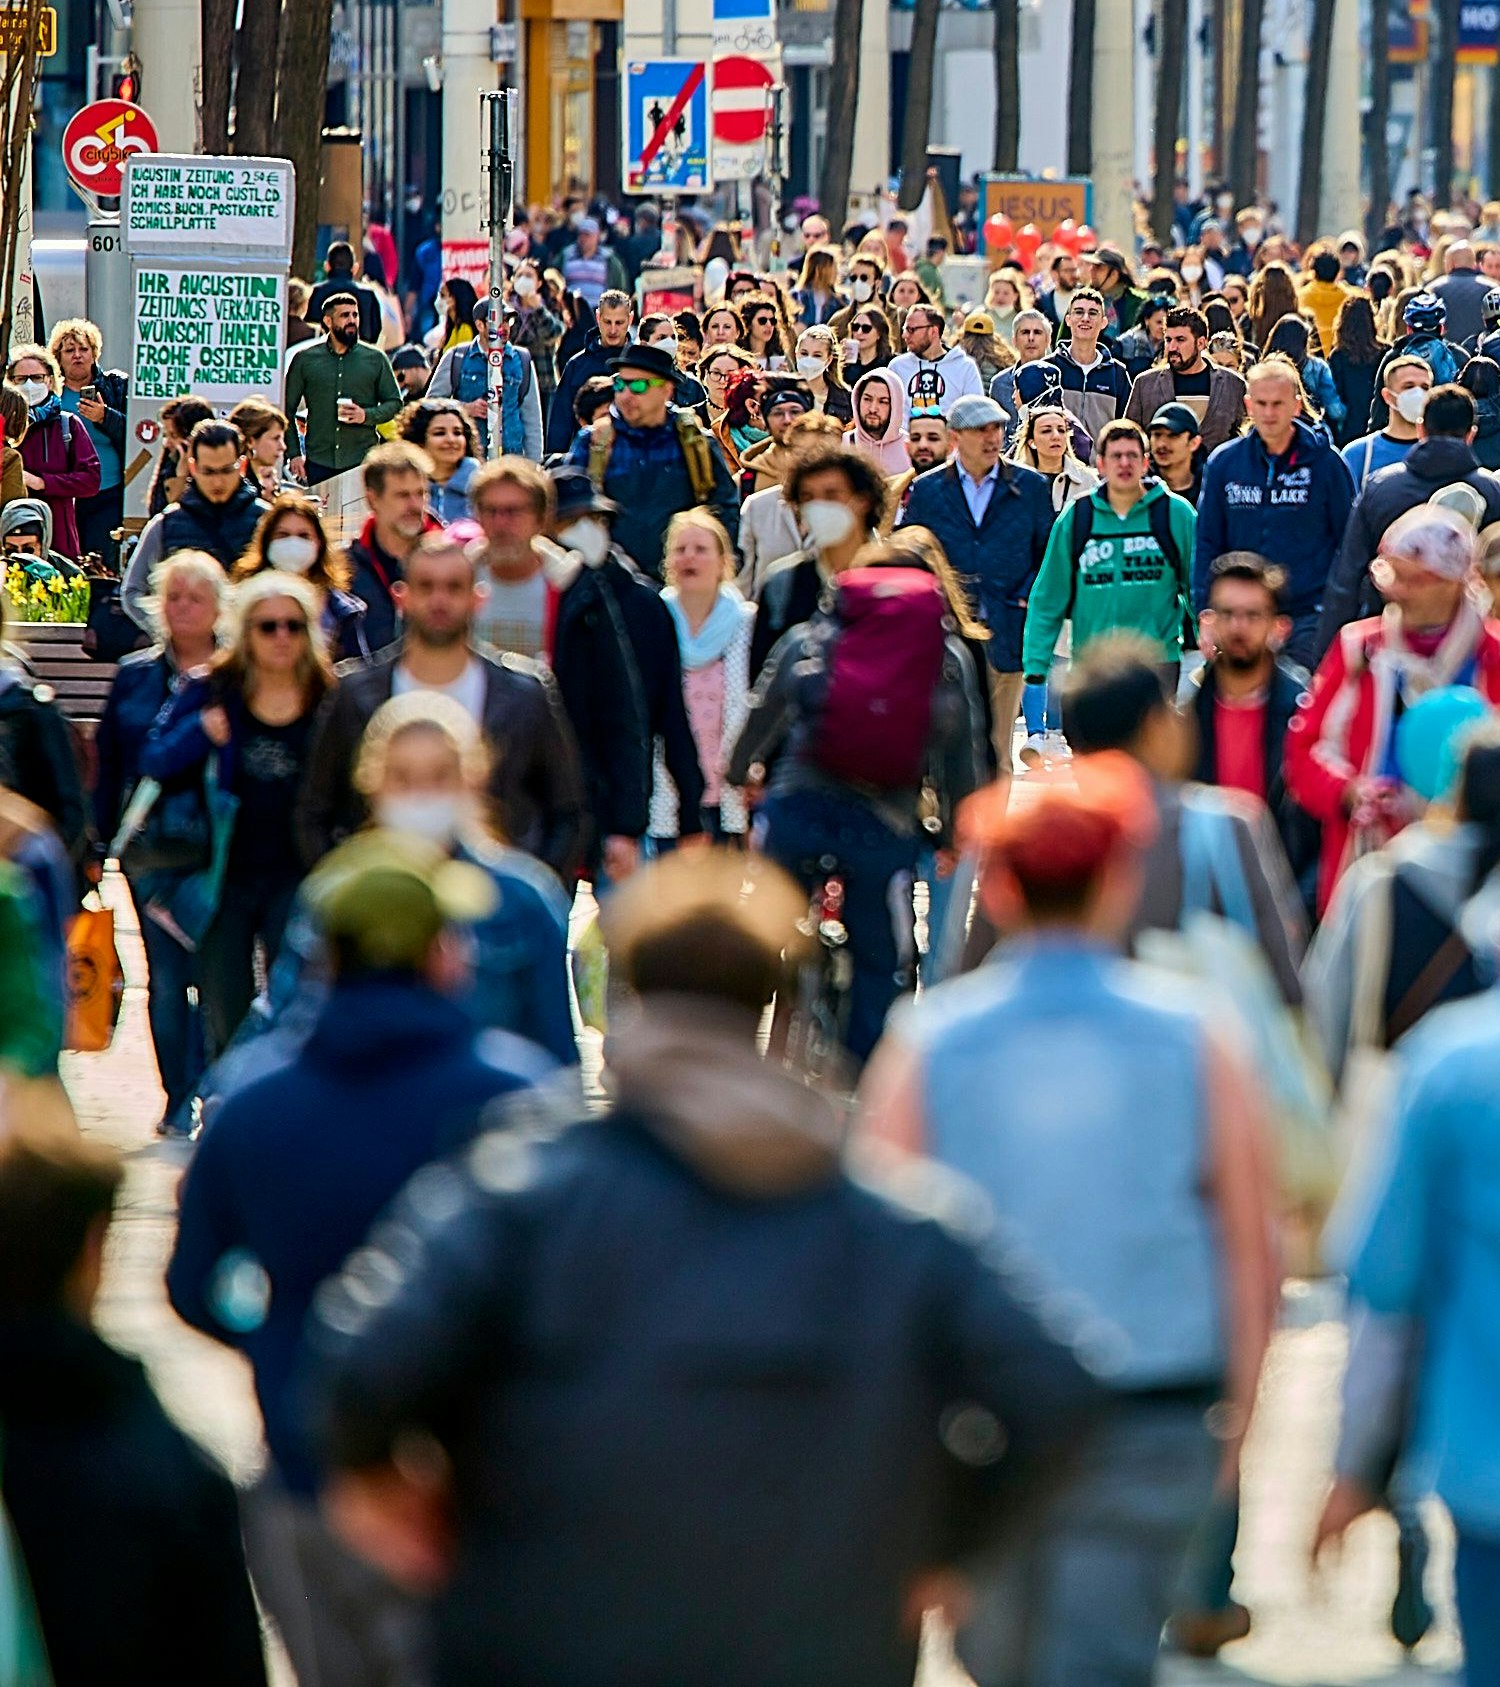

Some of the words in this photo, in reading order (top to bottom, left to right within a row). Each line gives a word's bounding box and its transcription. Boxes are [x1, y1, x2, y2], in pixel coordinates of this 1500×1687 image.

[131, 167, 181, 182] AUGUSTIN
[186, 169, 234, 184] ZEITUNG
[131, 184, 148, 198] ICH
[154, 184, 184, 199] HABE
[188, 186, 220, 200] NOCH
[998, 196, 1074, 219] JESUS
[130, 216, 216, 230] SCHALLPLATTE
[138, 272, 170, 294] IHR
[178, 274, 278, 299] AUGUSTIN
[138, 295, 207, 319] ZEITUNGS
[137, 319, 214, 345] WÜNSCHT
[219, 322, 277, 347] IHNEN
[199, 346, 278, 370] OSTERN
[135, 365, 161, 383] UND
[166, 366, 186, 383] EIN
[135, 382, 191, 398] LEBEN
[1270, 489, 1309, 504] LAKE
